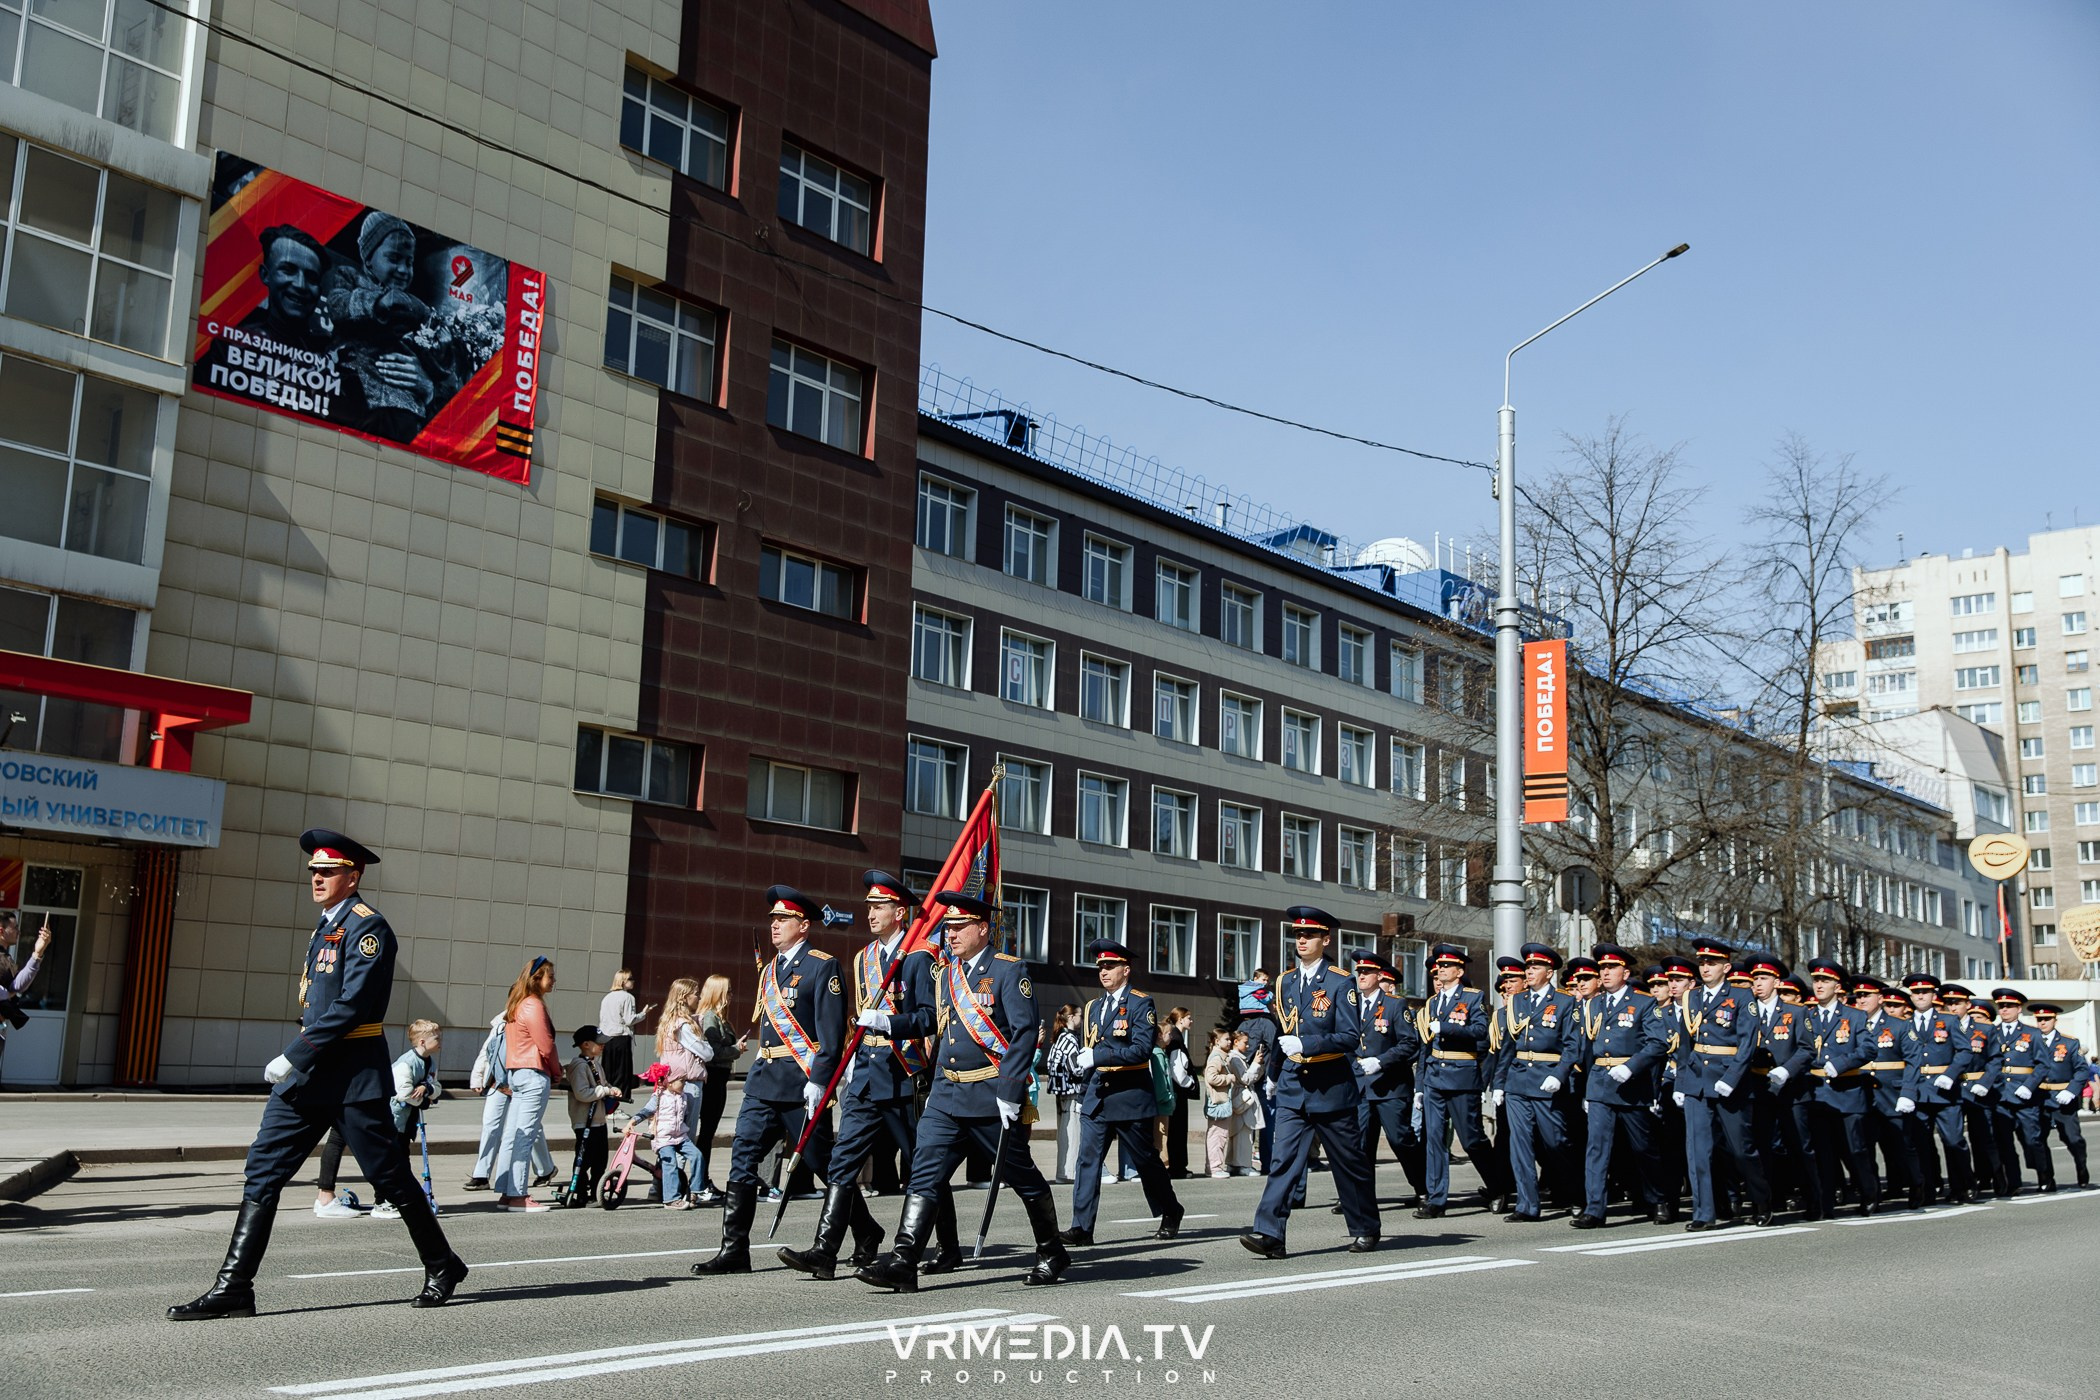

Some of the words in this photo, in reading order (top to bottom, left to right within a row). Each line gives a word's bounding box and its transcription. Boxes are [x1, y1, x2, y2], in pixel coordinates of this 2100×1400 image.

[449, 286, 473, 304] МАЯ
[207, 321, 219, 334] С
[223, 325, 326, 368] ПРАЗДНИКОМ
[513, 278, 541, 412] ПОБЕДА!
[210, 364, 330, 416] ПОБЕДЫ!
[227, 345, 341, 396] ВЕЛИКОЙ
[1537, 652, 1555, 752] ПОБЕДА!
[0, 762, 99, 790] ОВСКИЙ
[46, 801, 208, 836] УНИВЕРСИТЕТ
